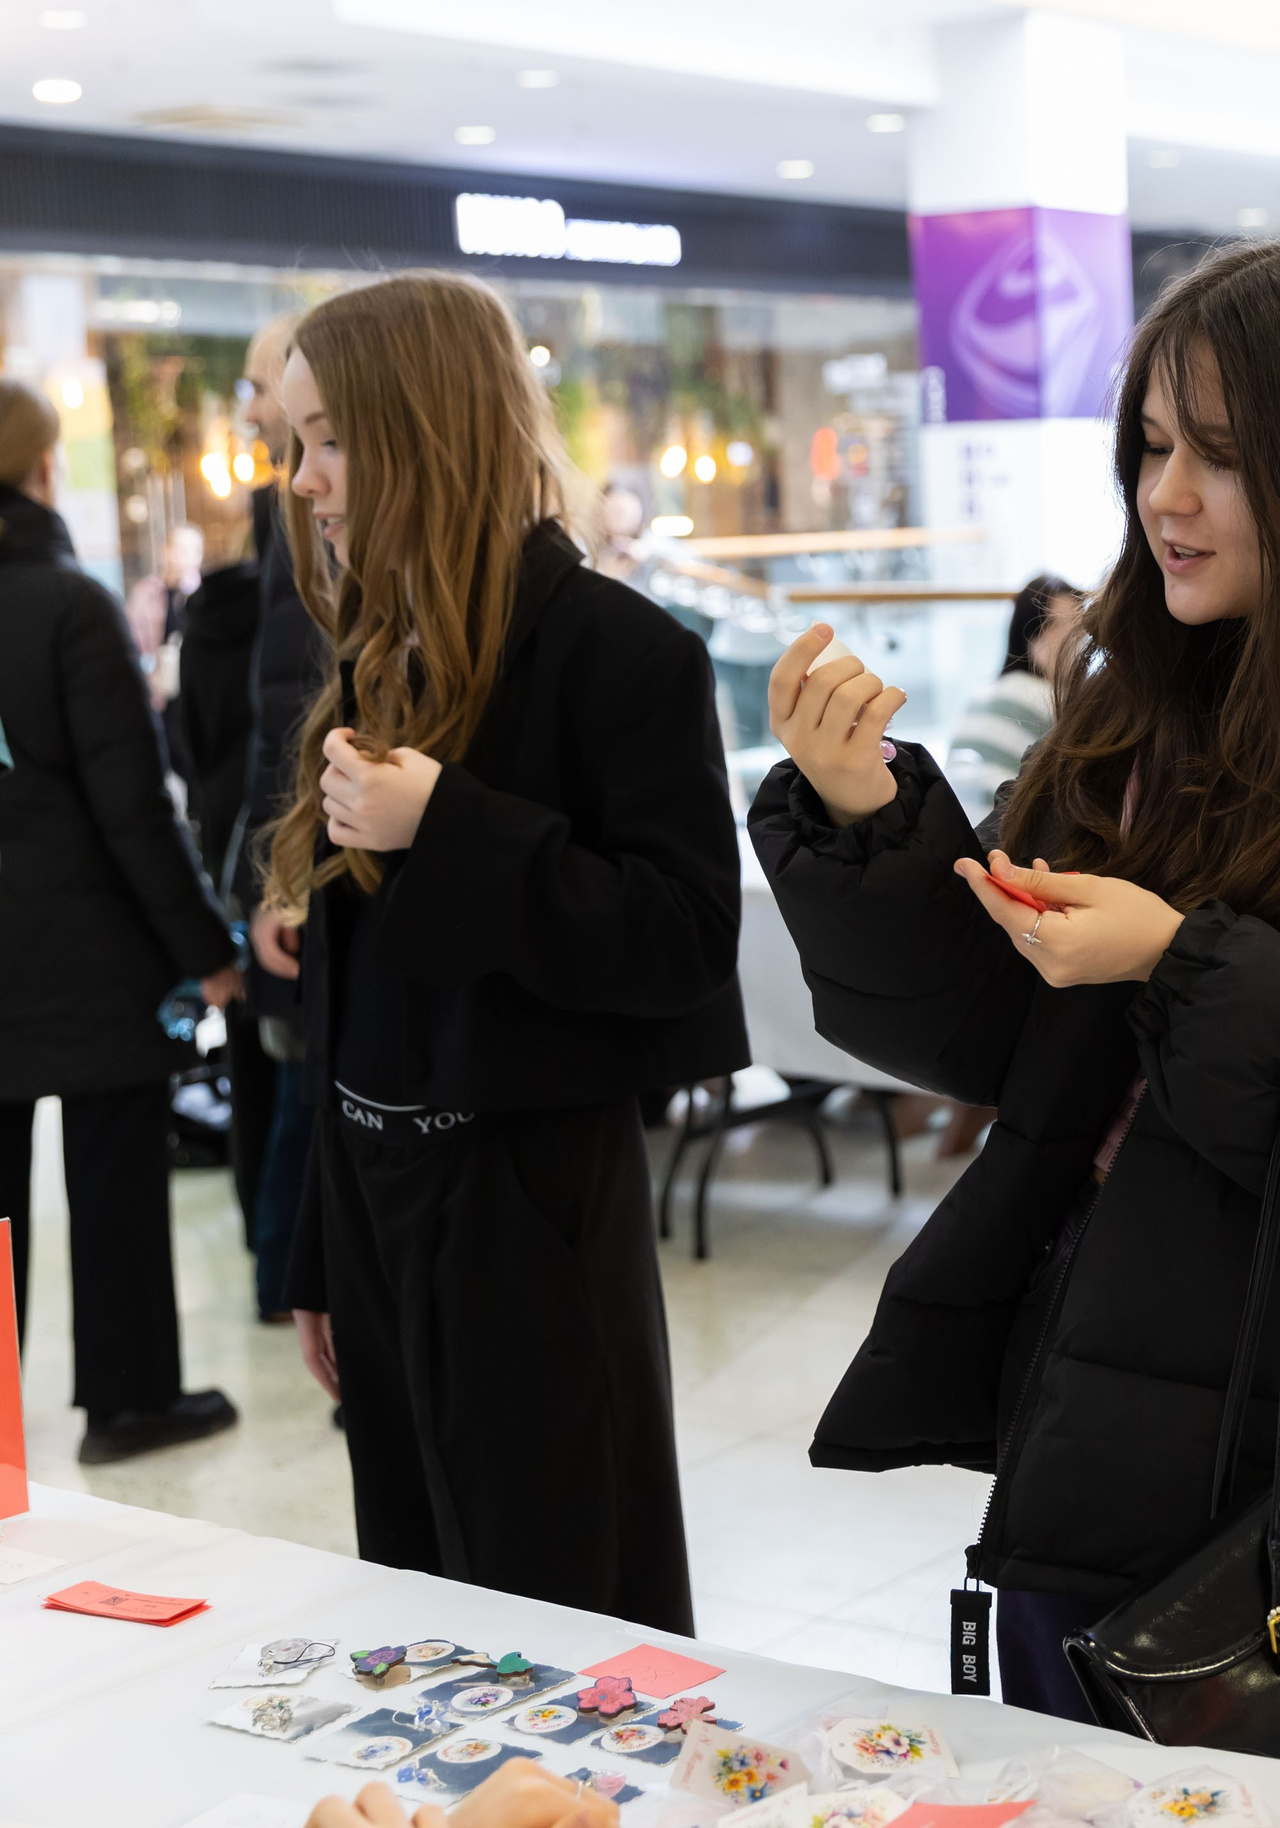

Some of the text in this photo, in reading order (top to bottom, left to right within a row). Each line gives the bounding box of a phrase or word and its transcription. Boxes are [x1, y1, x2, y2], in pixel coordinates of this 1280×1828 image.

[342, 1100, 384, 1131] CAN
[962, 1621, 977, 1683] BIG BOY
